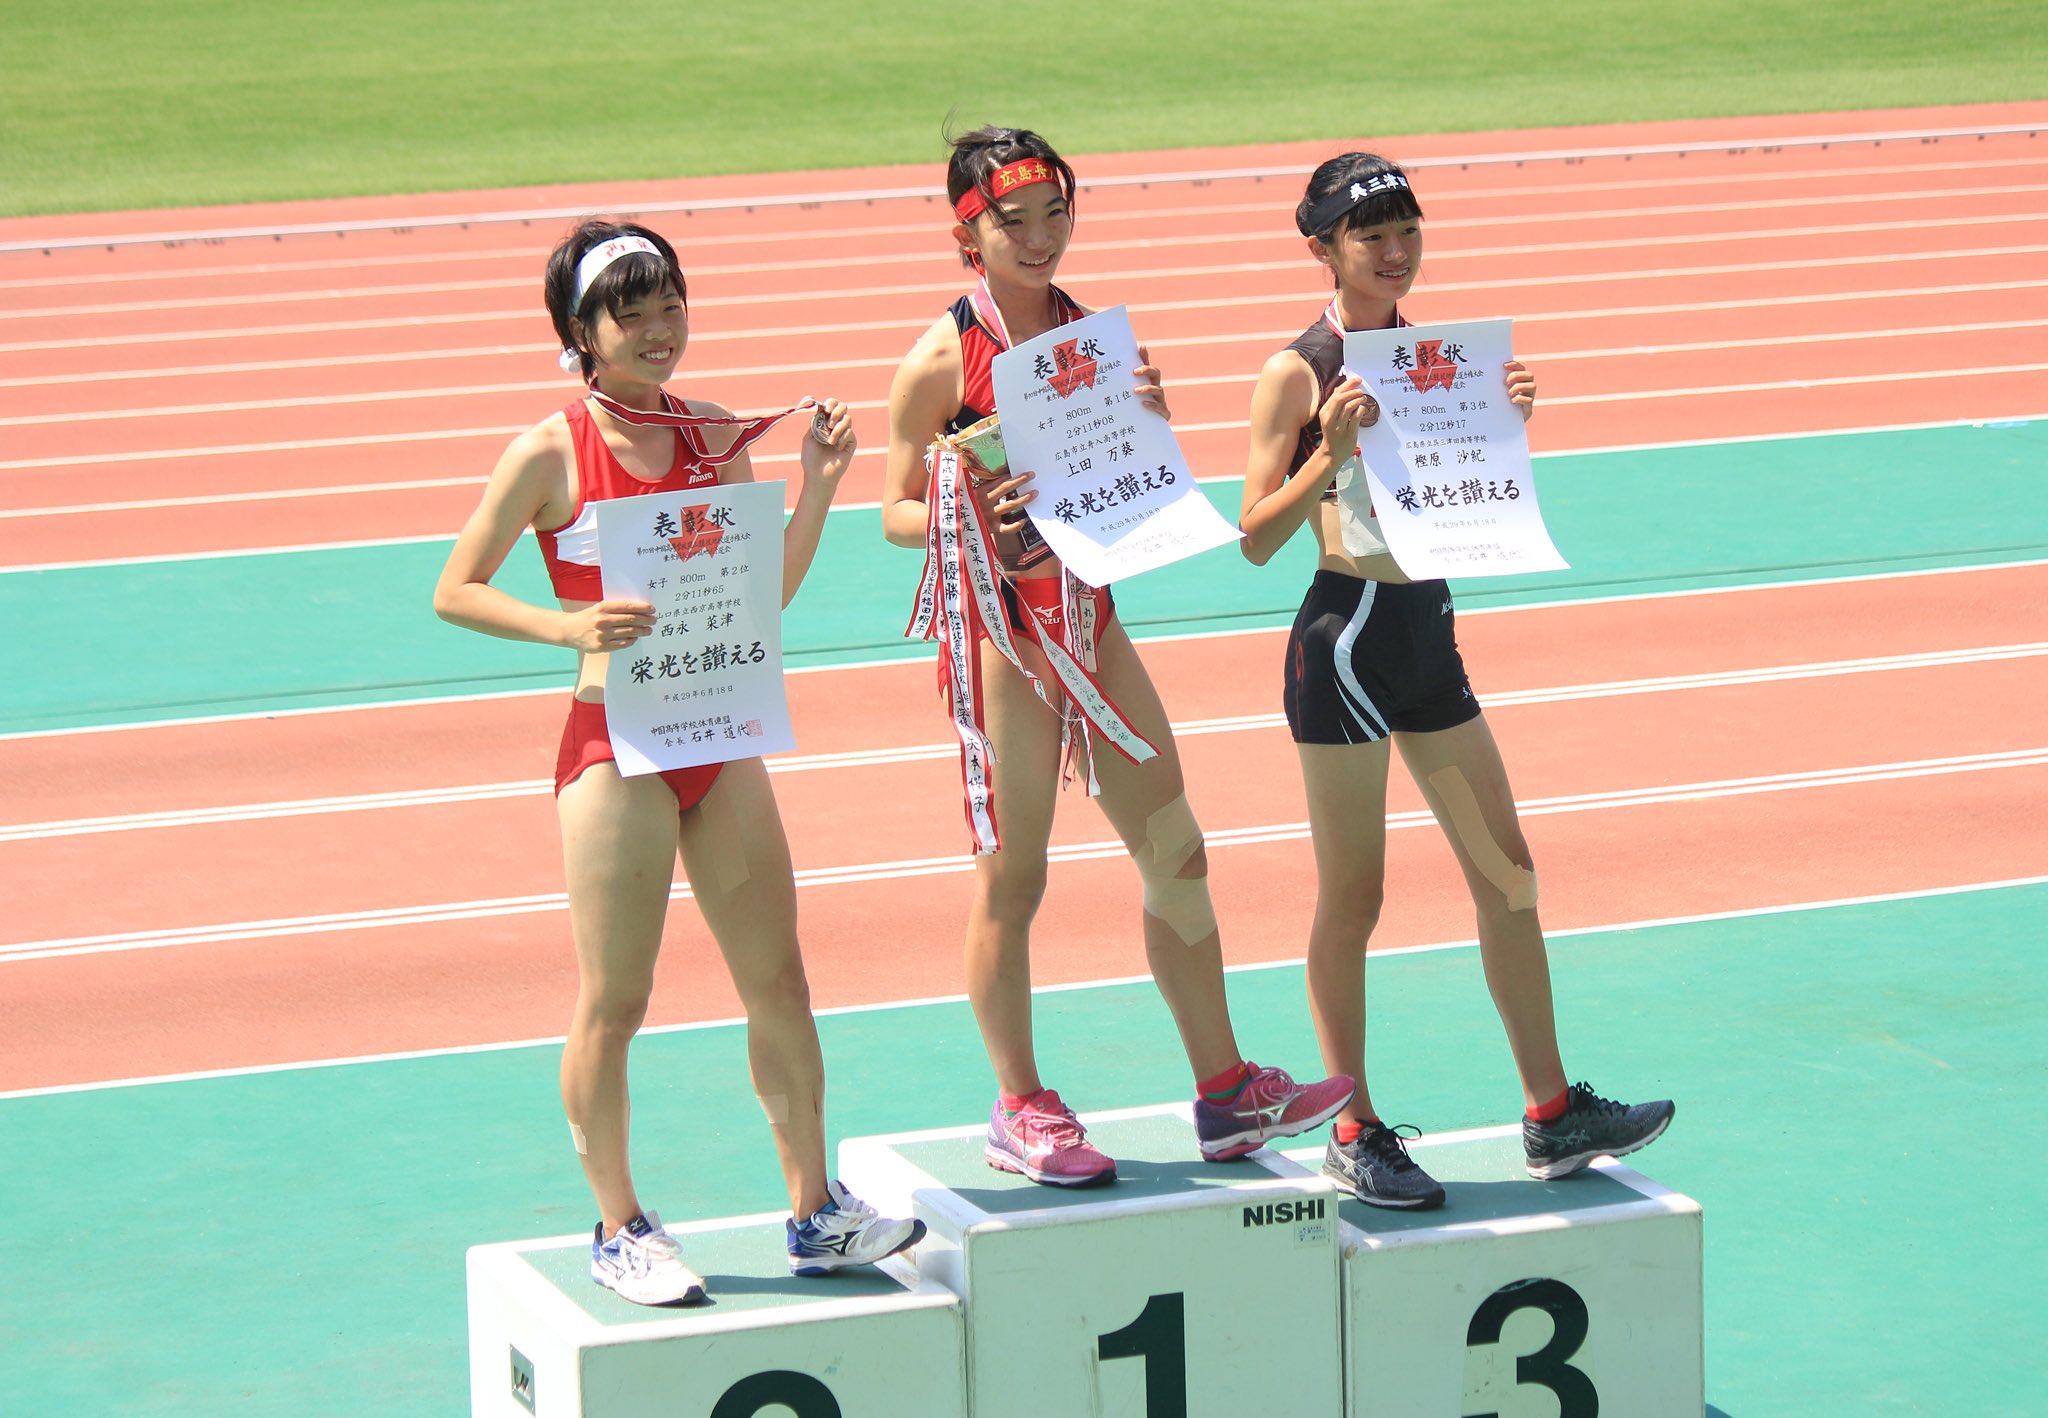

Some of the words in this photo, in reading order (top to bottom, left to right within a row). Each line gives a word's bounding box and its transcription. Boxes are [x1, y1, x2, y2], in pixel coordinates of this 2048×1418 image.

[1033, 338, 1105, 380] 表彰状
[1391, 344, 1468, 370] 表彰状
[1037, 417, 1055, 431] 女子
[1066, 405, 1092, 420] 800m
[1104, 390, 1132, 407] 第1位
[1392, 407, 1410, 418] 女子
[1421, 405, 1446, 415] 800m
[1459, 400, 1488, 412] 第3位
[1066, 414, 1115, 439] 2分11秒08
[1419, 419, 1467, 432] 2分12秒17
[1067, 458, 1092, 478] 上田
[1106, 441, 1134, 462] 万葵
[1457, 448, 1485, 464] 沙紀
[1054, 465, 1175, 524] 栄光を讃える
[1396, 477, 1520, 512] 栄光を讃える
[653, 507, 736, 538] 表彰状
[647, 577, 668, 590] 女子
[680, 573, 706, 584] 800m
[720, 564, 750, 577] 第2位
[675, 585, 724, 602] 2分11秒65
[661, 620, 689, 637] 西永
[630, 641, 766, 684] 栄光を讃える
[663, 685, 733, 703] 平成29年6月18日
[1243, 1199, 1325, 1228] NISHI
[1098, 1292, 1187, 1418] 1
[1461, 1277, 1600, 1418] 3
